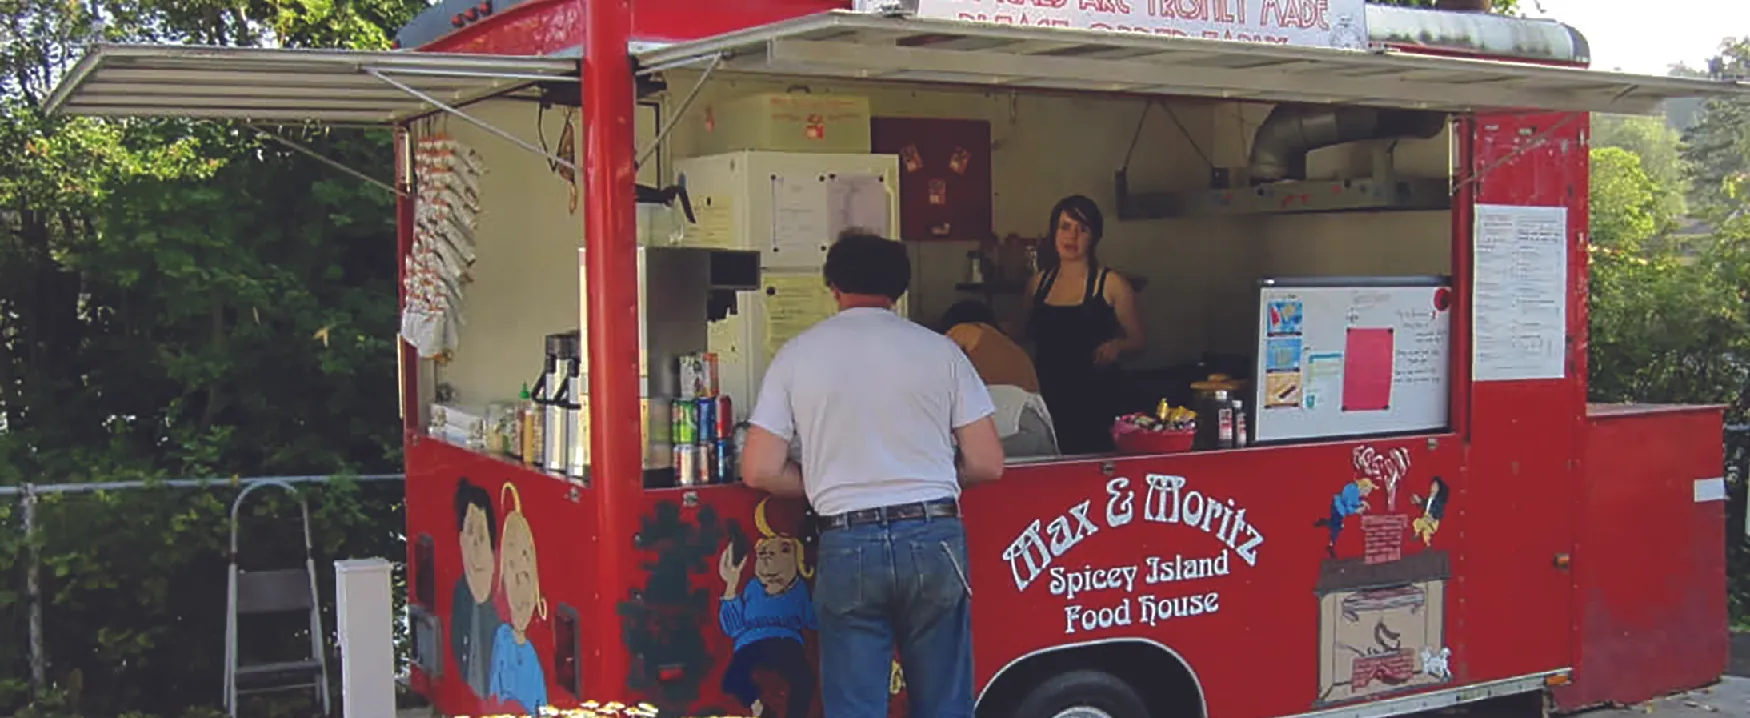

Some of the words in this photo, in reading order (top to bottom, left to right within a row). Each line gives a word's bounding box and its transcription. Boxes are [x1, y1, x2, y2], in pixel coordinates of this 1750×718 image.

[1260, 0, 1330, 30] MADE
[1002, 499, 1099, 592] Max
[1106, 477, 1135, 528] &
[1143, 473, 1264, 567] Moritz
[1050, 565, 1138, 600] Spicey
[1146, 549, 1230, 584] Island
[1064, 598, 1132, 634] Food
